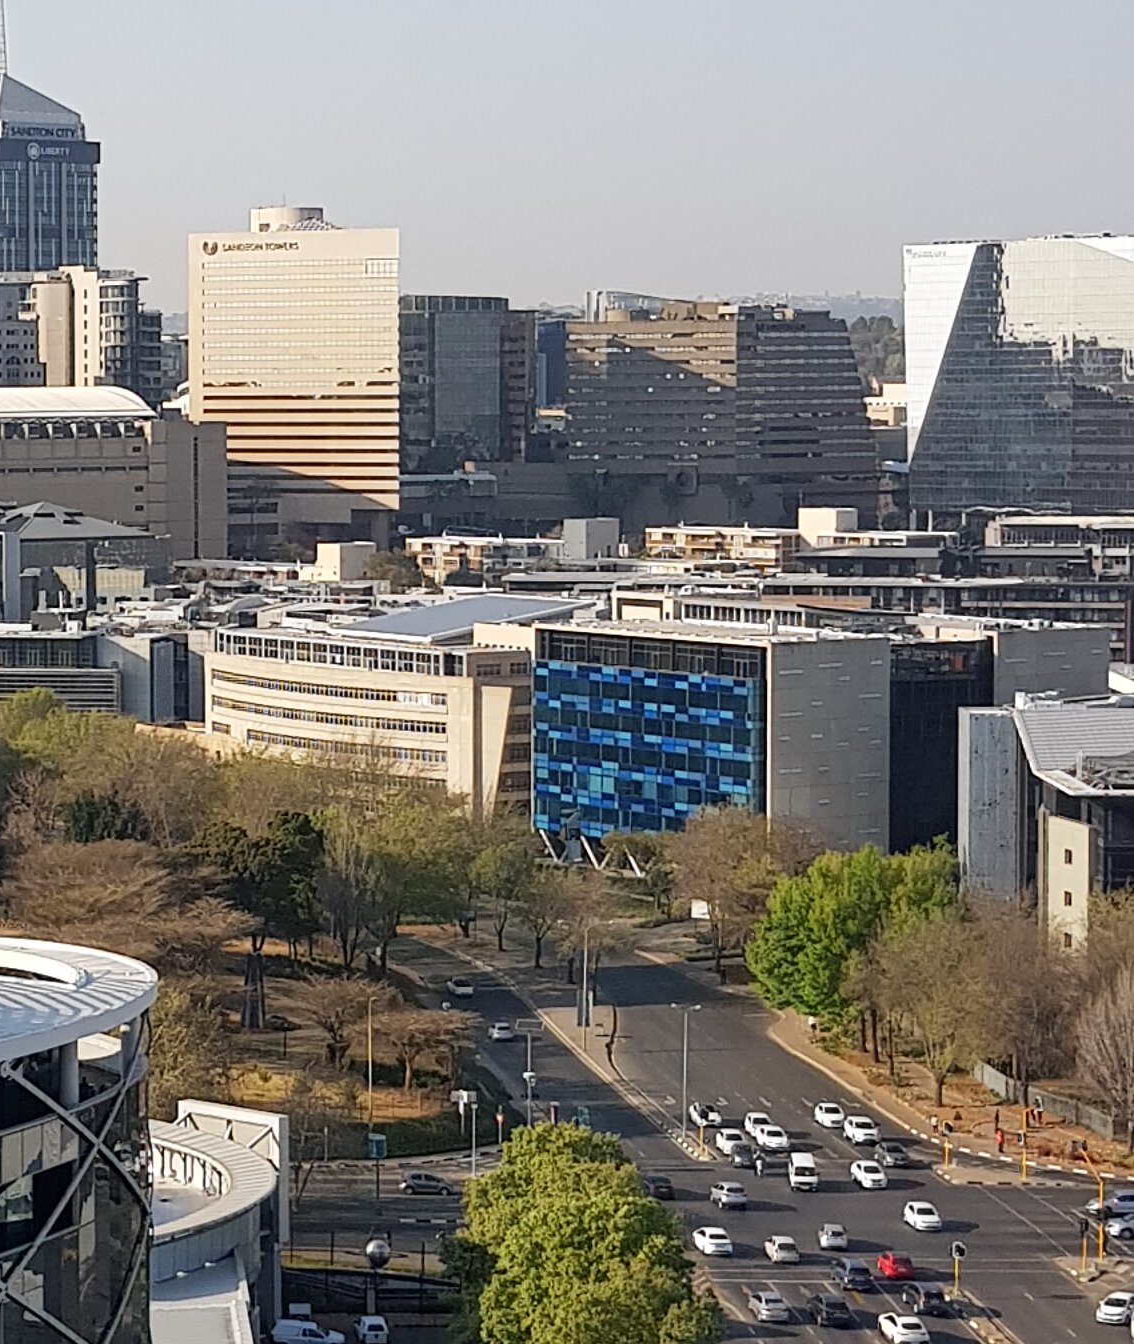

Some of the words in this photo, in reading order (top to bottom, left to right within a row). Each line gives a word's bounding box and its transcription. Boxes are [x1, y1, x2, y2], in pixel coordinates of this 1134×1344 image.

[11, 127, 54, 137] SANDTON
[55, 128, 76, 138] CITY
[39, 147, 70, 156] LIBERTY
